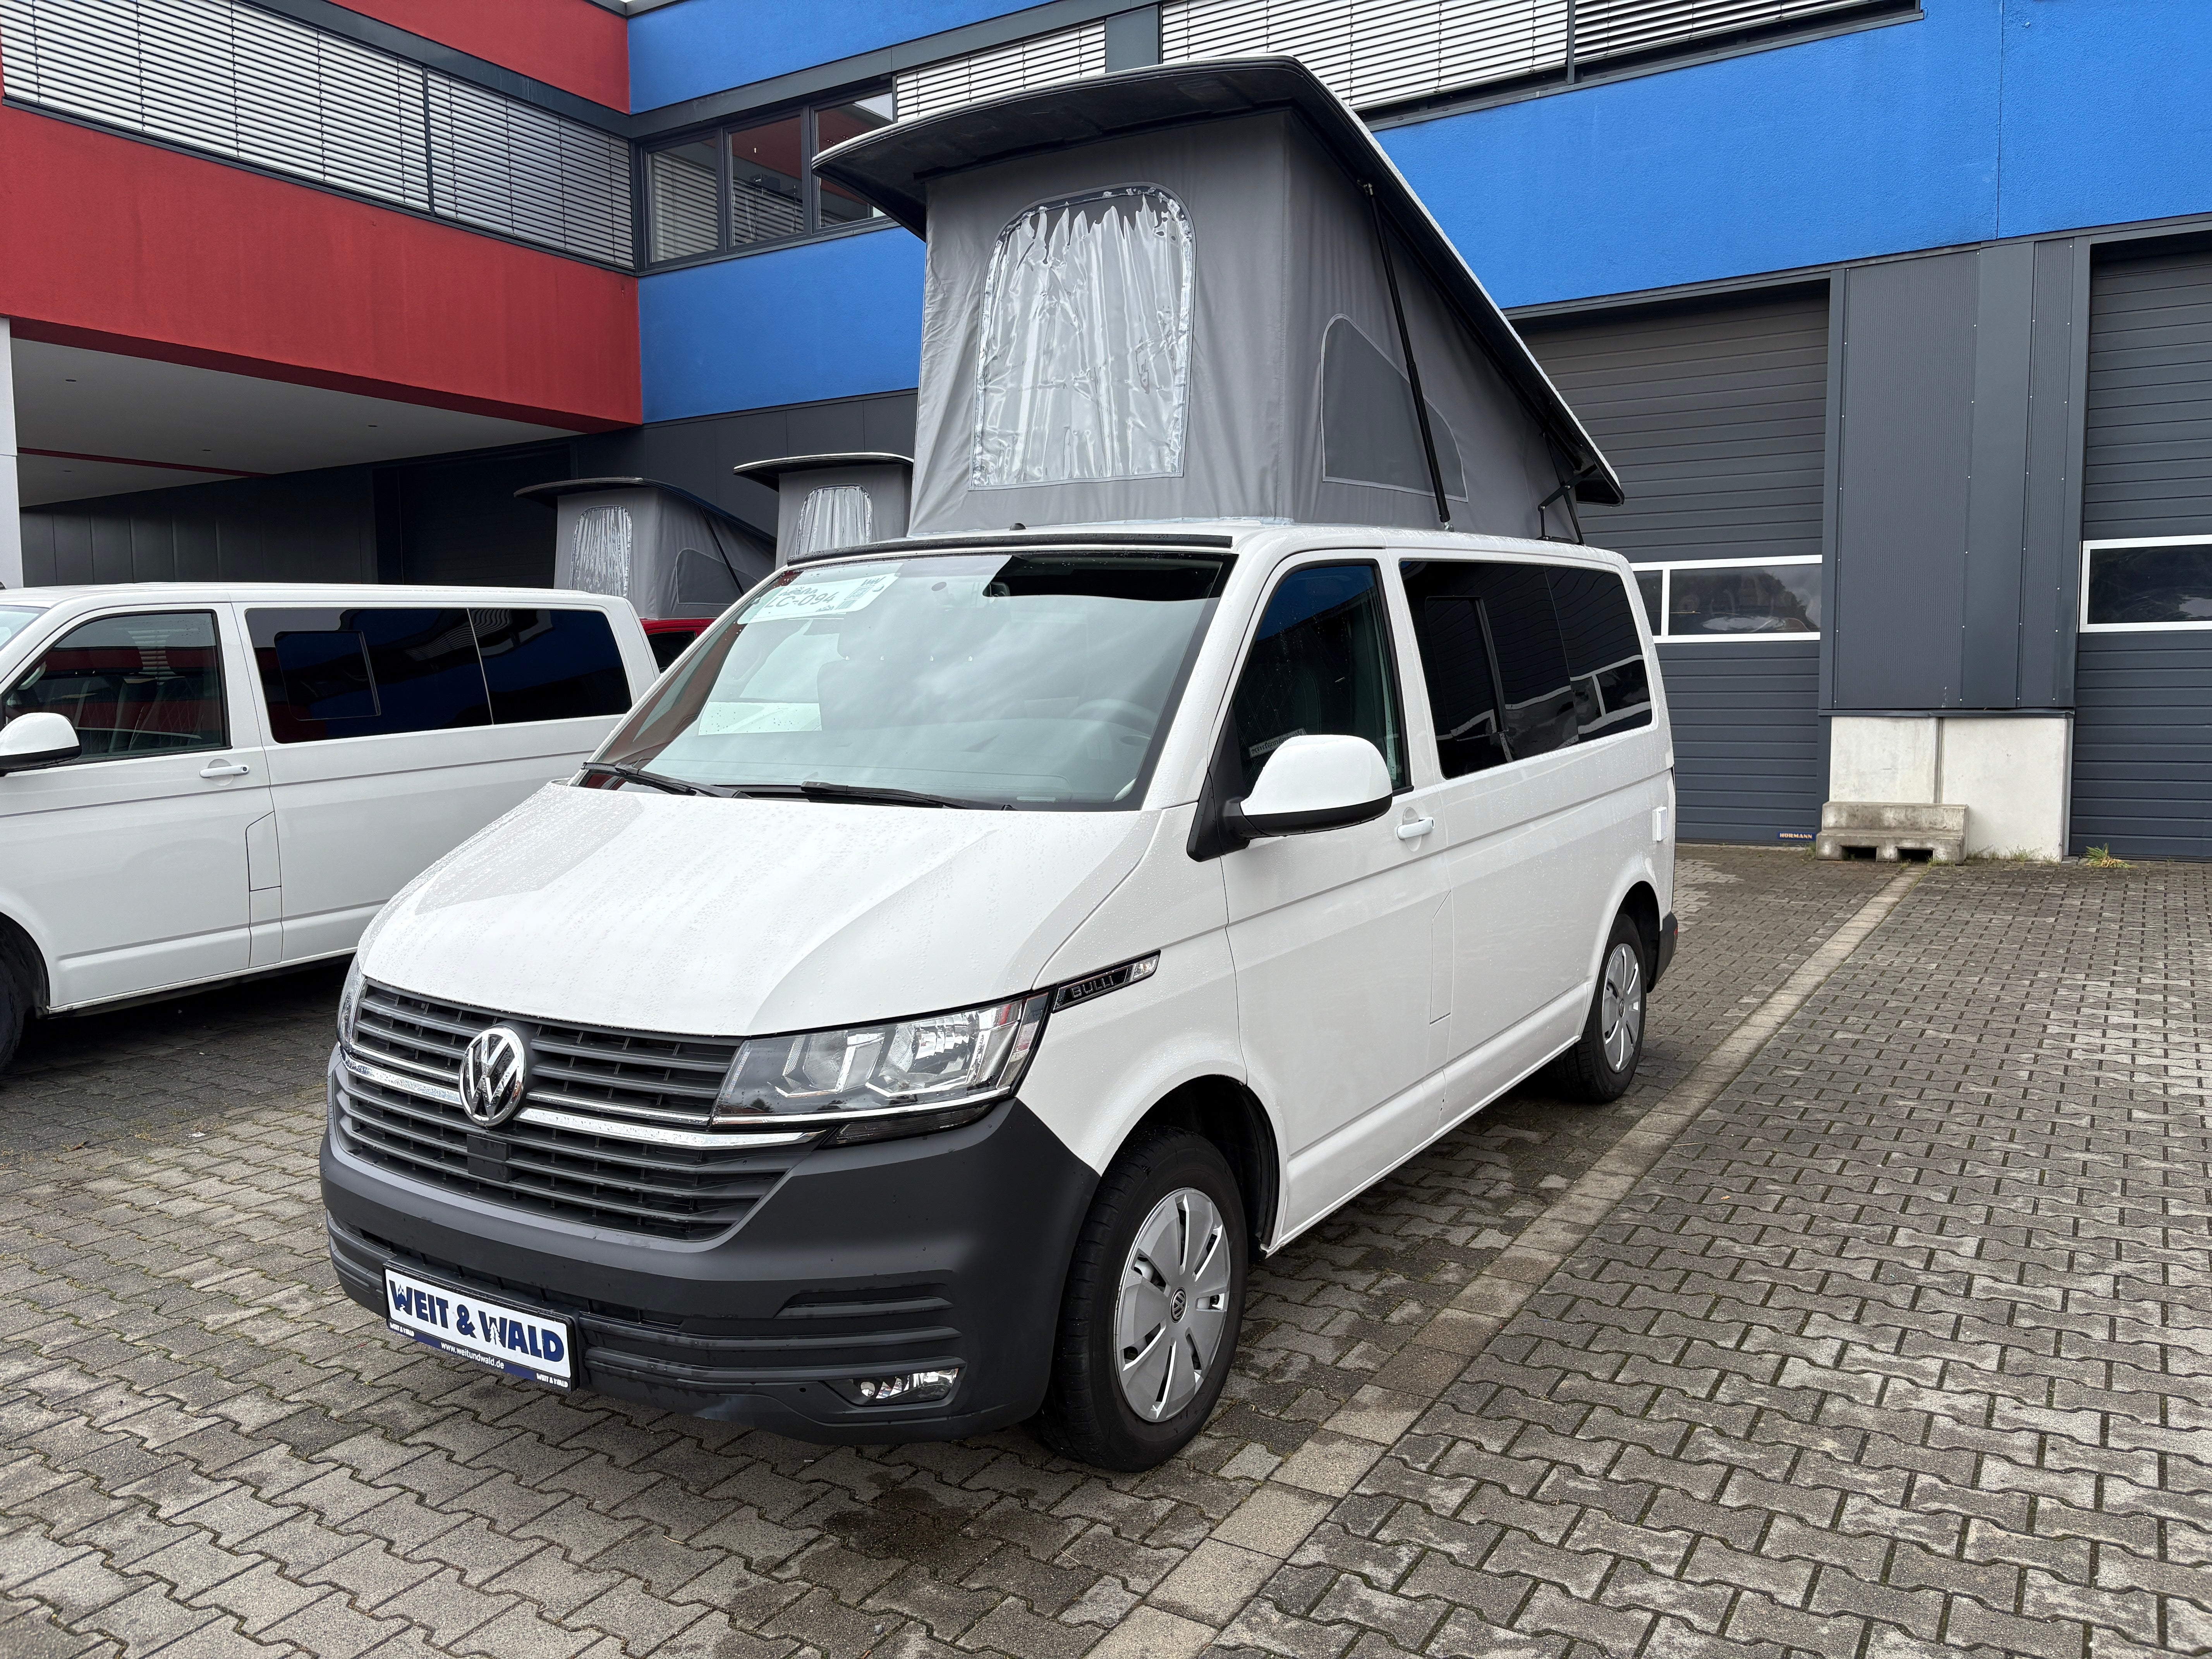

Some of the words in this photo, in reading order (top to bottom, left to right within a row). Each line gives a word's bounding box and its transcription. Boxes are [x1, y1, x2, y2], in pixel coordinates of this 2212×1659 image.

[1070, 975, 1114, 998] BULLI
[459, 1026, 525, 1125] VW
[389, 1279, 449, 1329] WEIT
[456, 1304, 477, 1339] &
[478, 1310, 565, 1362] WALD
[441, 1342, 505, 1369] www.weitundwald.de
